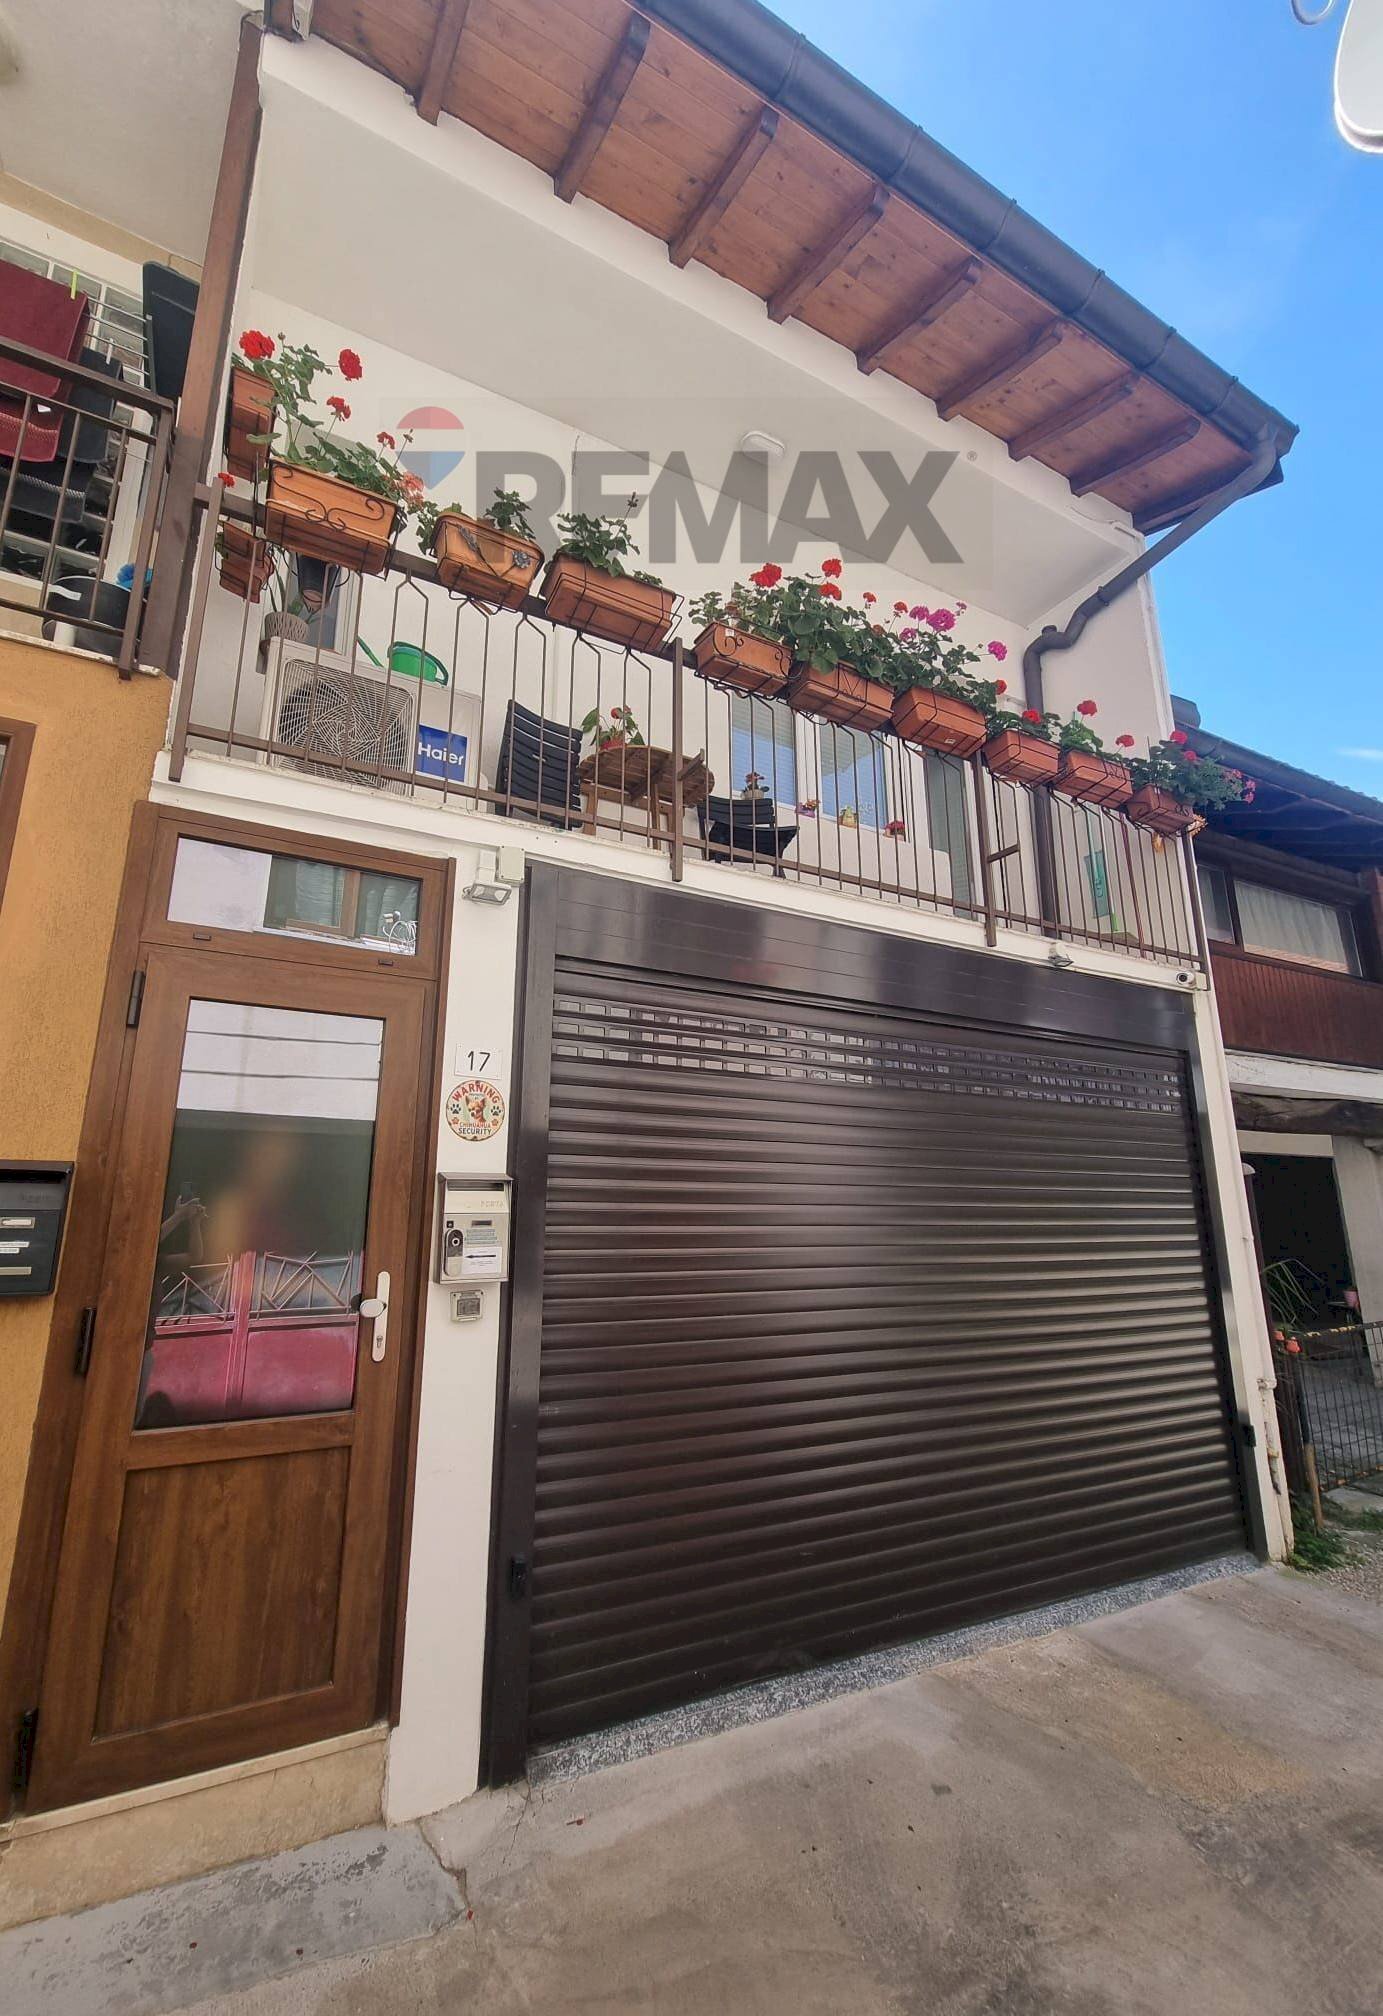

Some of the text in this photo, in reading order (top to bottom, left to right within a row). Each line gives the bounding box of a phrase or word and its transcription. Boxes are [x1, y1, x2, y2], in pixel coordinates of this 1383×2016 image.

[417, 742, 464, 766] Haier
[467, 1050, 491, 1072] 17
[452, 1083, 501, 1104] WARNING
[458, 1127, 492, 1135] SECURITY
